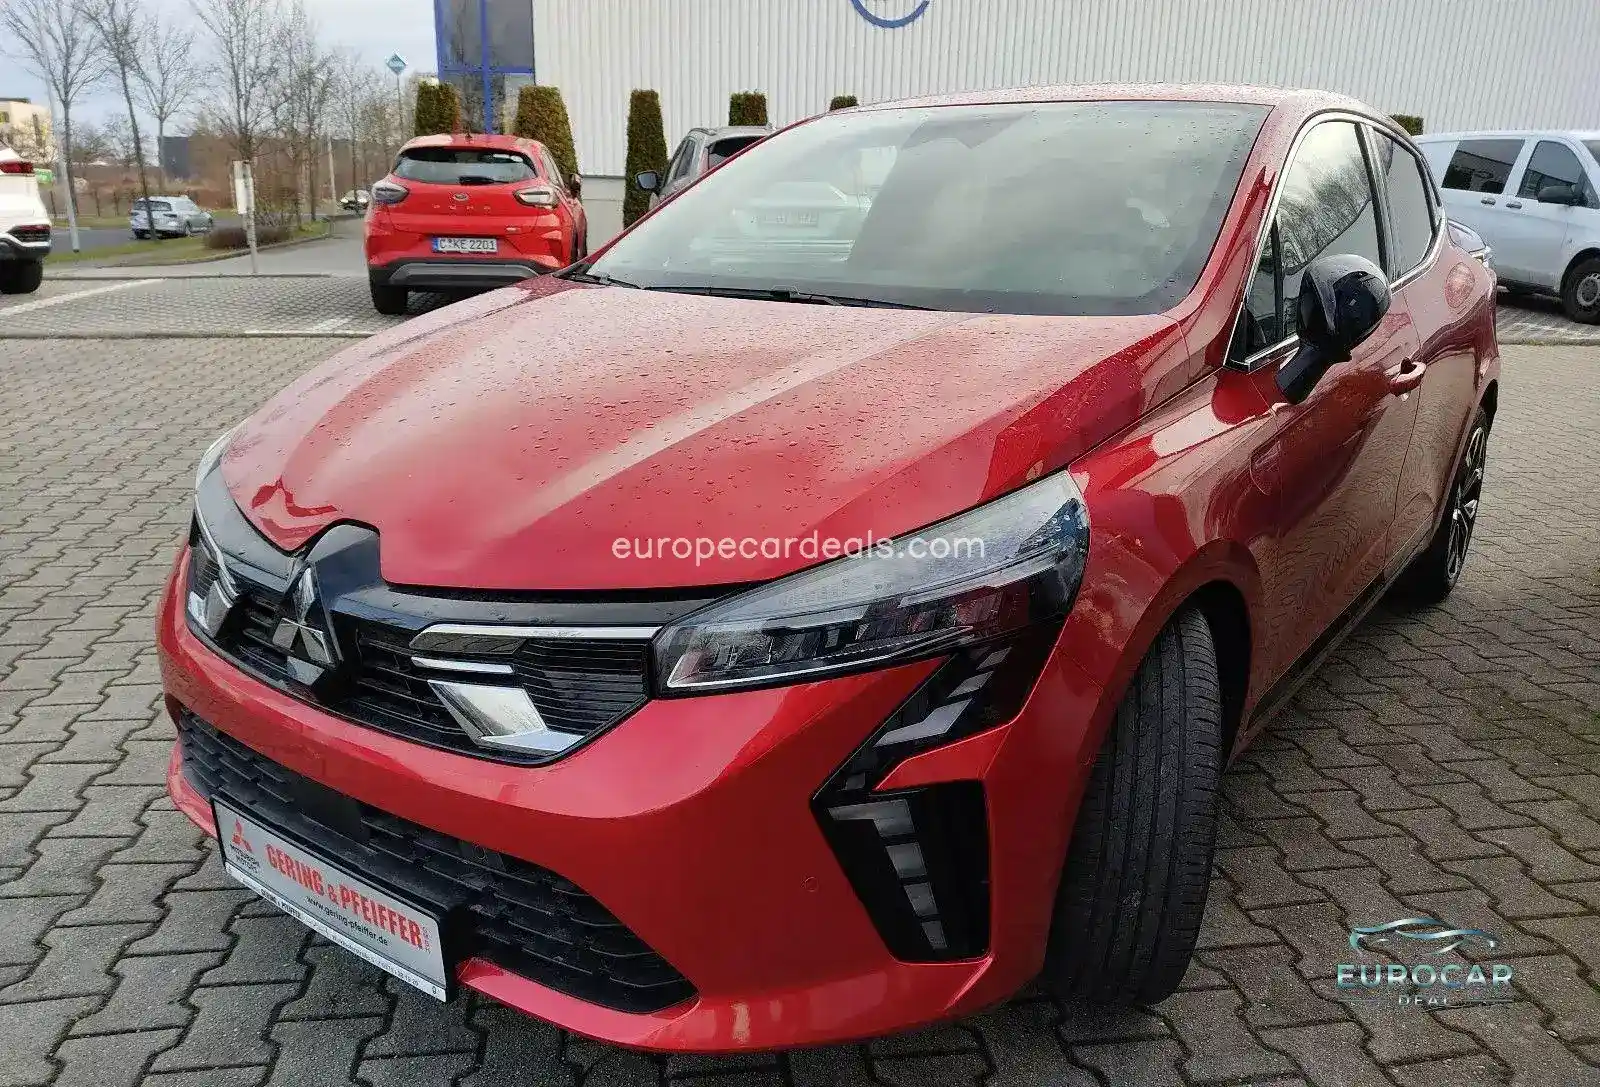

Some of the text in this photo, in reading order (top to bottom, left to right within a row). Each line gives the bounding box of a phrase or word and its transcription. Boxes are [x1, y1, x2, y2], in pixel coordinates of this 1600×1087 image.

[469, 240, 495, 250] 2201
[265, 843, 423, 949] GERING & PFEIFFER
[306, 895, 389, 947] www.gering-pfeiffer.de
